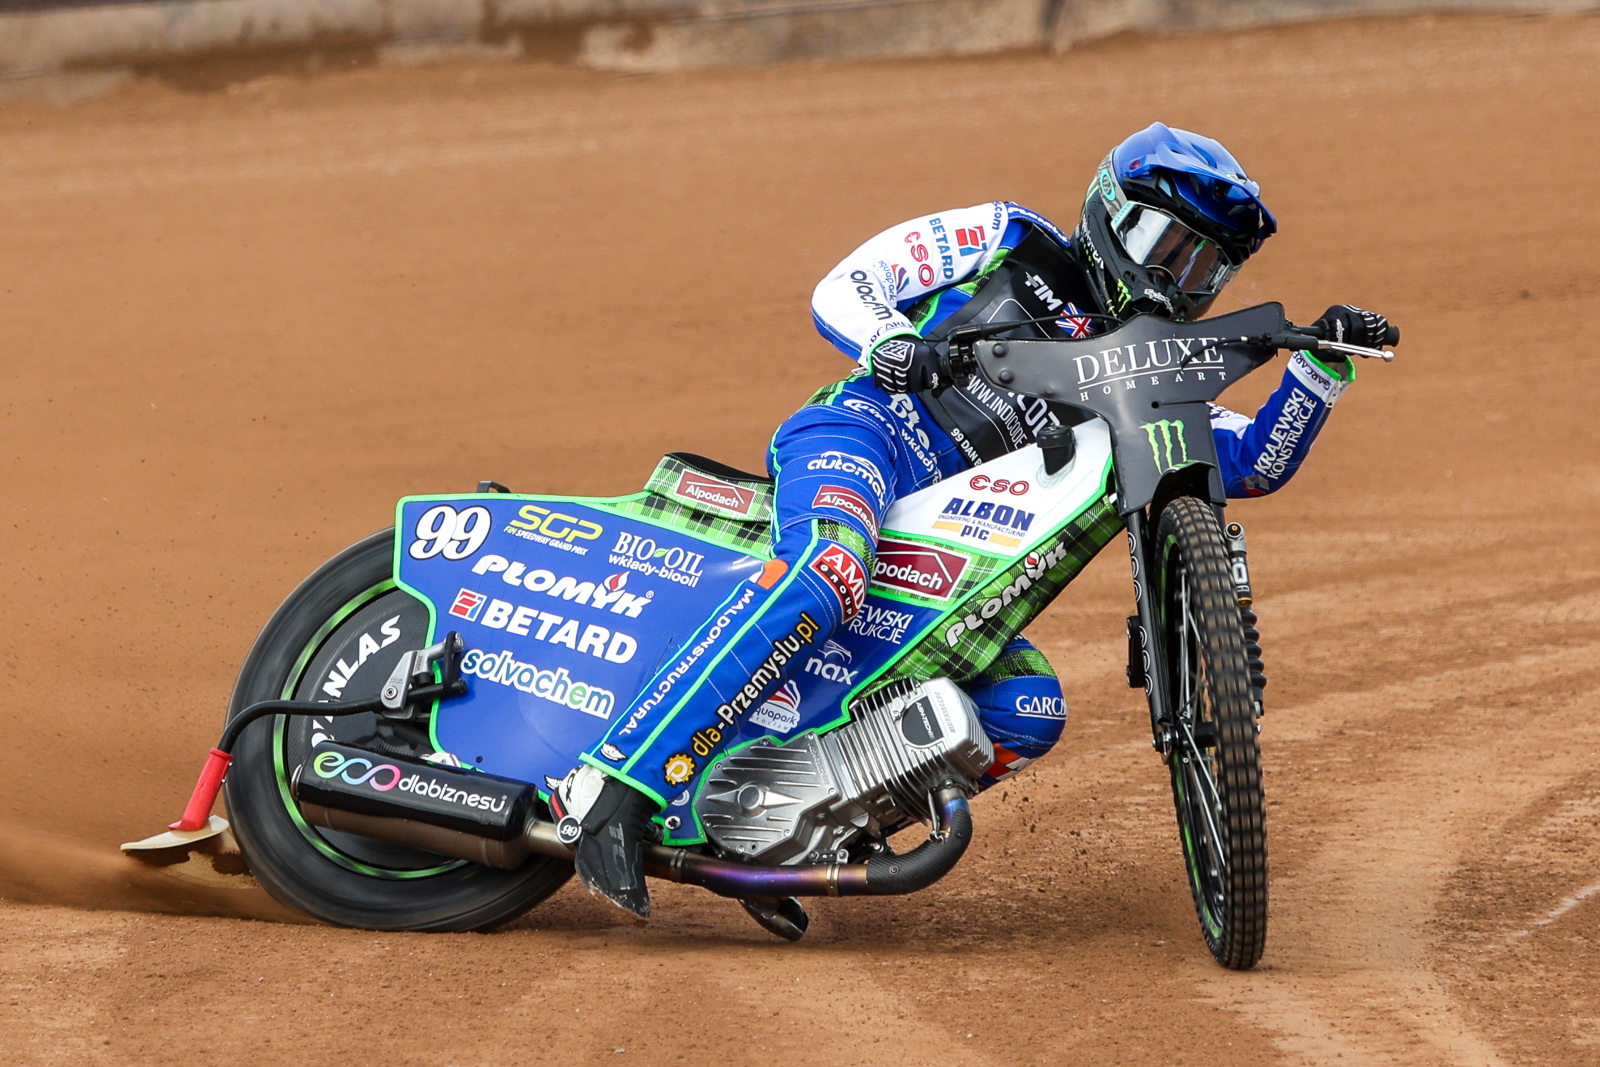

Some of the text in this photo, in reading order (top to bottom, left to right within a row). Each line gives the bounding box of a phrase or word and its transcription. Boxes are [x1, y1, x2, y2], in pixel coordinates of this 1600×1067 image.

[928, 217, 955, 280] BETARD
[1028, 273, 1064, 312] FIM
[1073, 337, 1225, 385] DELUXE
[1080, 371, 1228, 402] HOMEART
[950, 427, 964, 442] 99
[960, 440, 981, 464] DAN
[1254, 387, 1306, 475] KRAJEWSKI
[1267, 396, 1318, 480] KONSTRUKCJE
[685, 484, 740, 509] Alpodach
[820, 494, 876, 537] Alpodach
[942, 496, 1036, 532] ALBON
[409, 505, 492, 560] 99
[503, 525, 589, 556] FIM SPEEDWAY GRAND PRIX
[509, 504, 604, 543] SGP
[937, 514, 971, 523] ENGINEERING
[976, 520, 1026, 538] MANUFACTURING
[960, 524, 990, 541] plc
[608, 554, 700, 588] wkłady-biooil
[819, 564, 853, 615] GROUP
[480, 598, 638, 664] BETARD
[618, 588, 756, 736] MALDONSTRUCTURAL
[804, 657, 860, 686] nax
[462, 650, 615, 719] solvachem
[398, 774, 508, 813] dlabiznesu
[562, 824, 578, 837] 99
